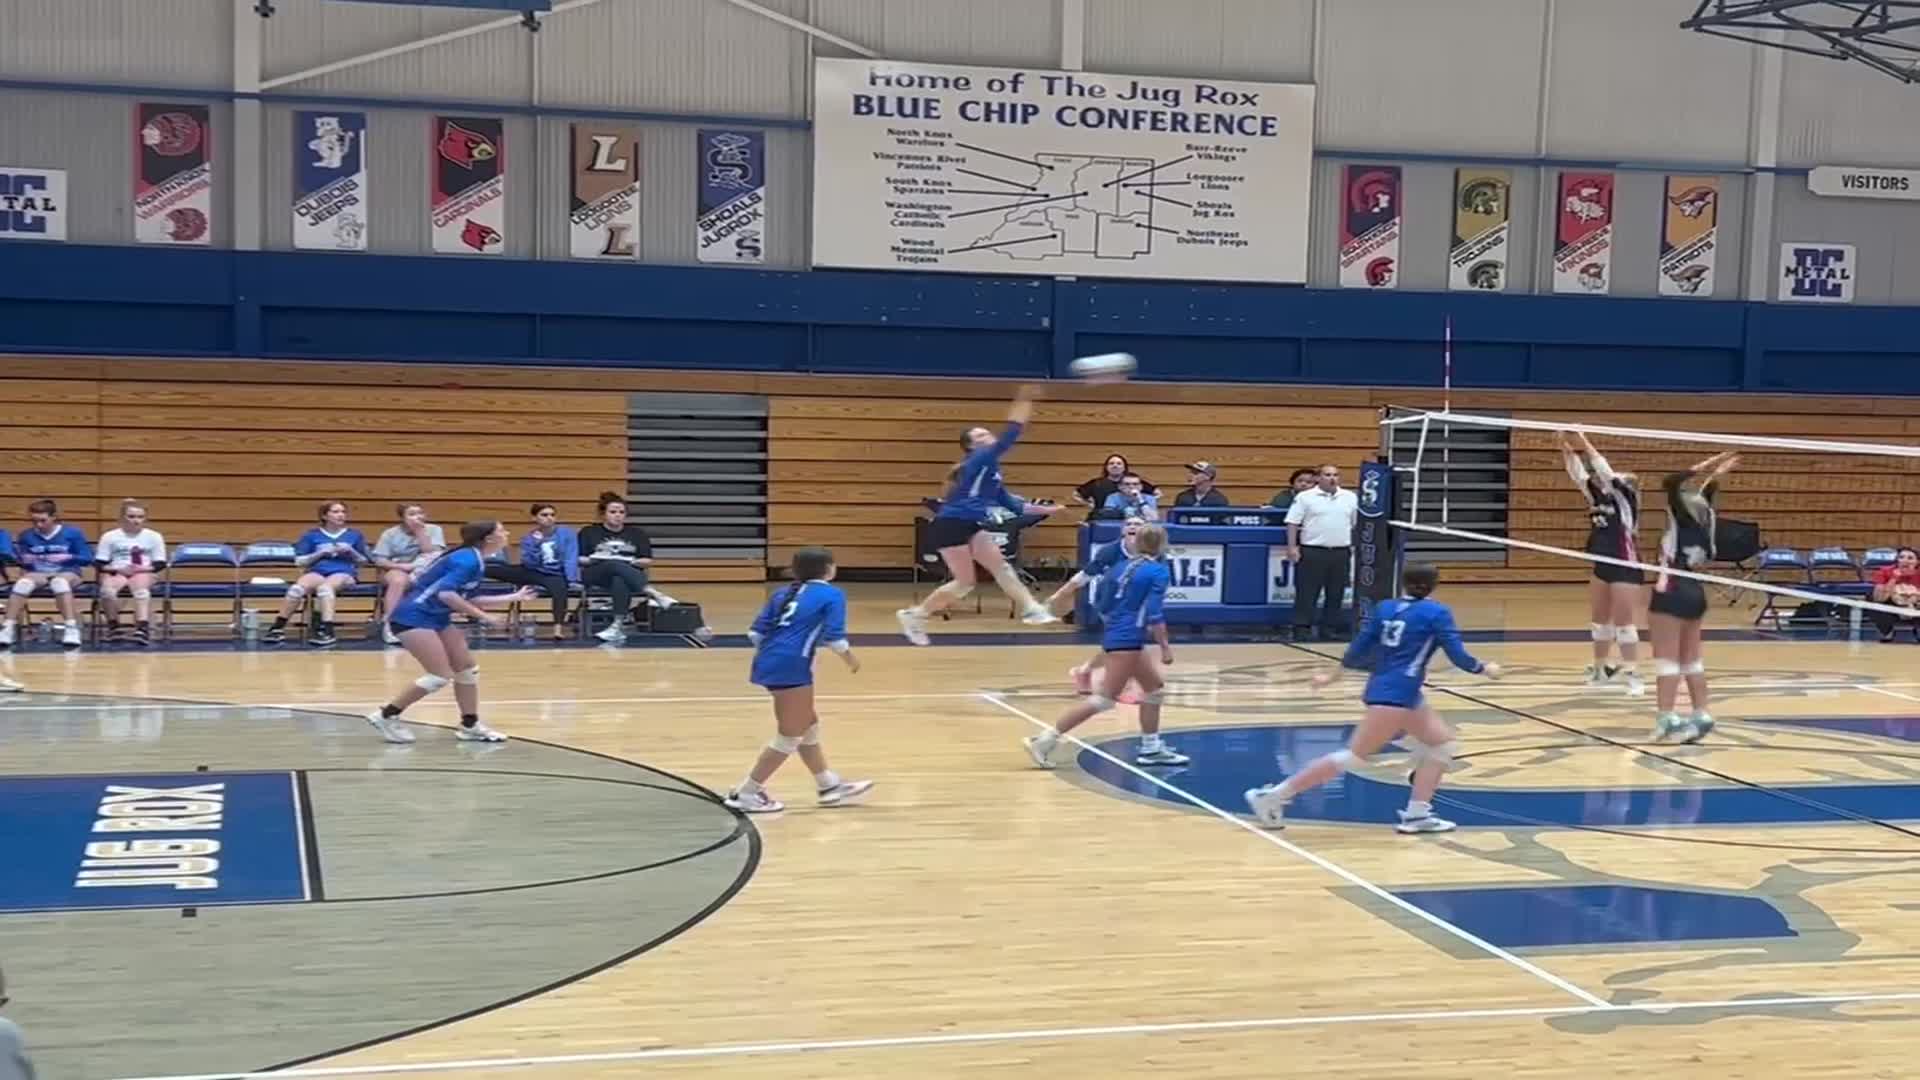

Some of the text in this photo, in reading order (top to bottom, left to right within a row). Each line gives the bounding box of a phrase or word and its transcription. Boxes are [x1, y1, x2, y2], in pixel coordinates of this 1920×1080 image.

[869, 68, 1259, 108] Home of The Jug Rox
[853, 94, 1278, 137] BLUE CHIP CONFERENCE
[296, 179, 359, 217] DUBOIS
[1841, 174, 1909, 190] VISITORS
[3, 196, 56, 212] TAL
[308, 194, 359, 227] JEEPS
[699, 192, 762, 232] SHOALS
[1784, 265, 1850, 280] METAL
[778, 601, 798, 626] 2
[1381, 620, 1406, 647] 13
[73, 783, 225, 889] JUG ROX
